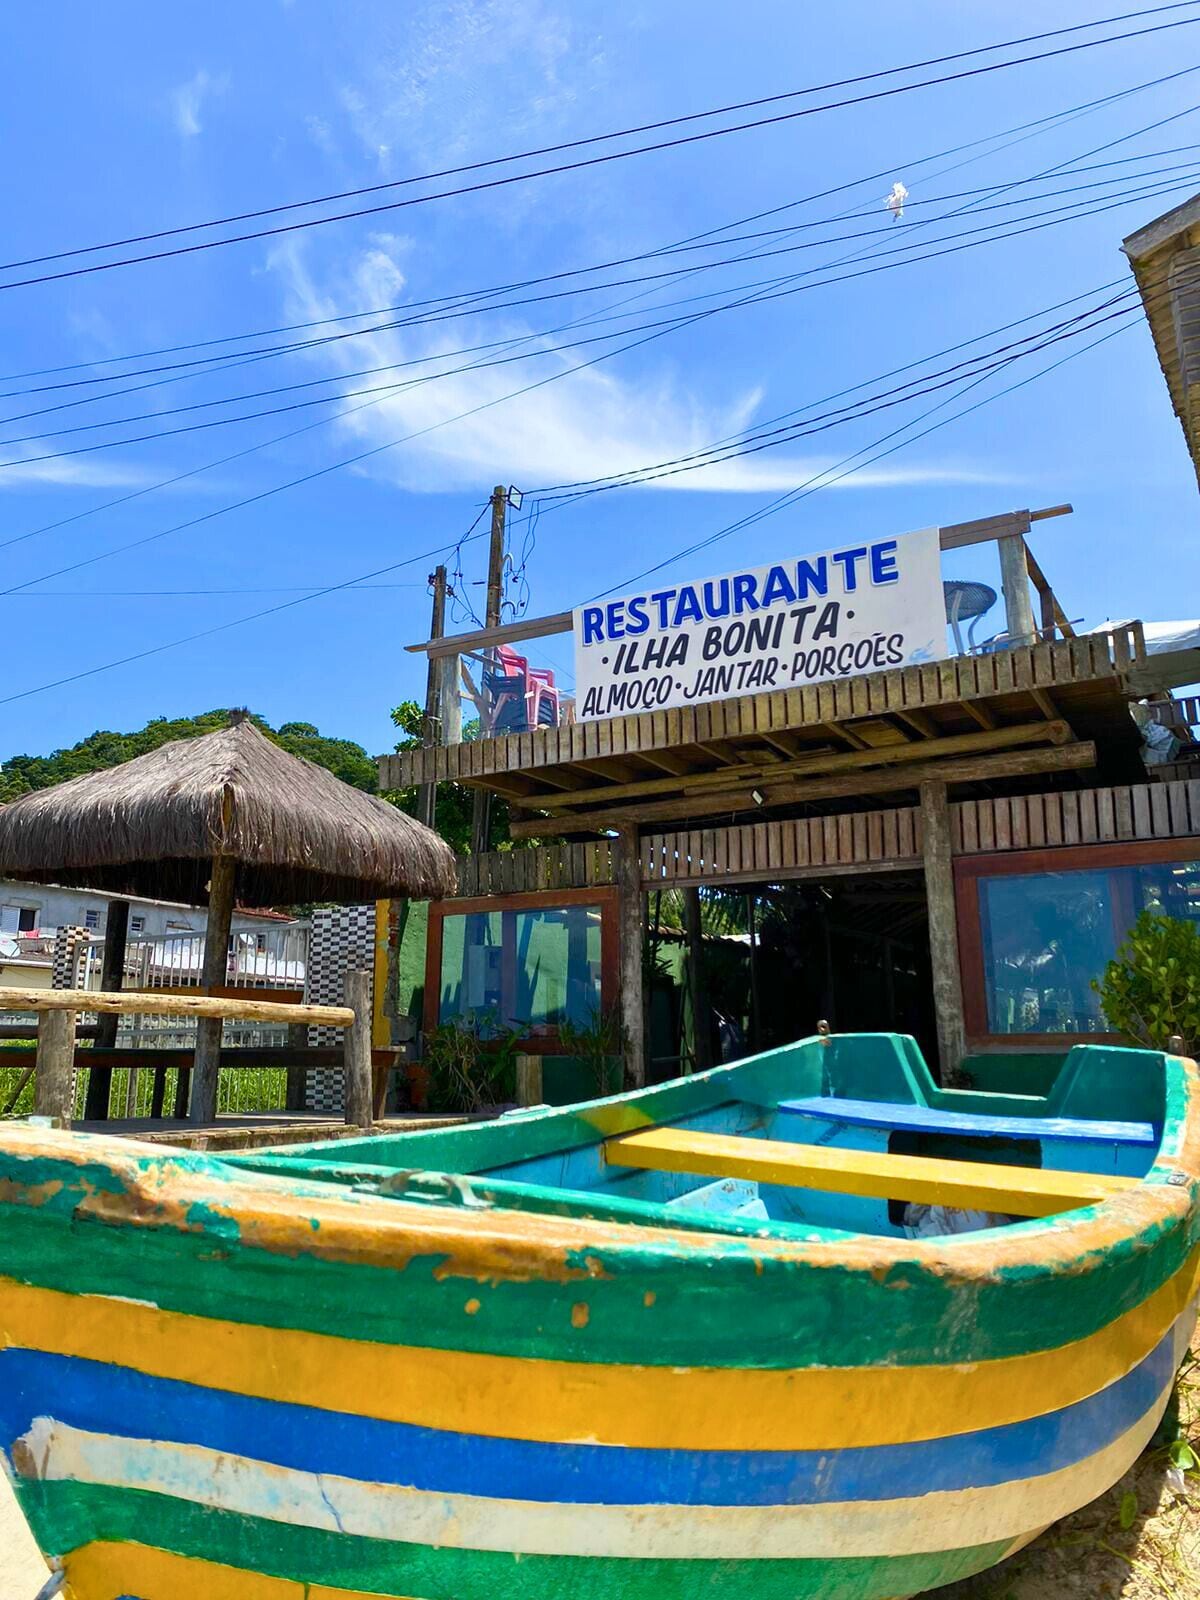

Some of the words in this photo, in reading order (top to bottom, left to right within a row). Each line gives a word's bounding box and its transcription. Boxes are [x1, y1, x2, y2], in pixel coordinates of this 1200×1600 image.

[583, 540, 899, 644] RESTAURANTE
[612, 632, 690, 676] ILHA
[702, 601, 841, 661] BONITA
[581, 674, 673, 717] ALMOÇO
[683, 656, 778, 699] JANTAR
